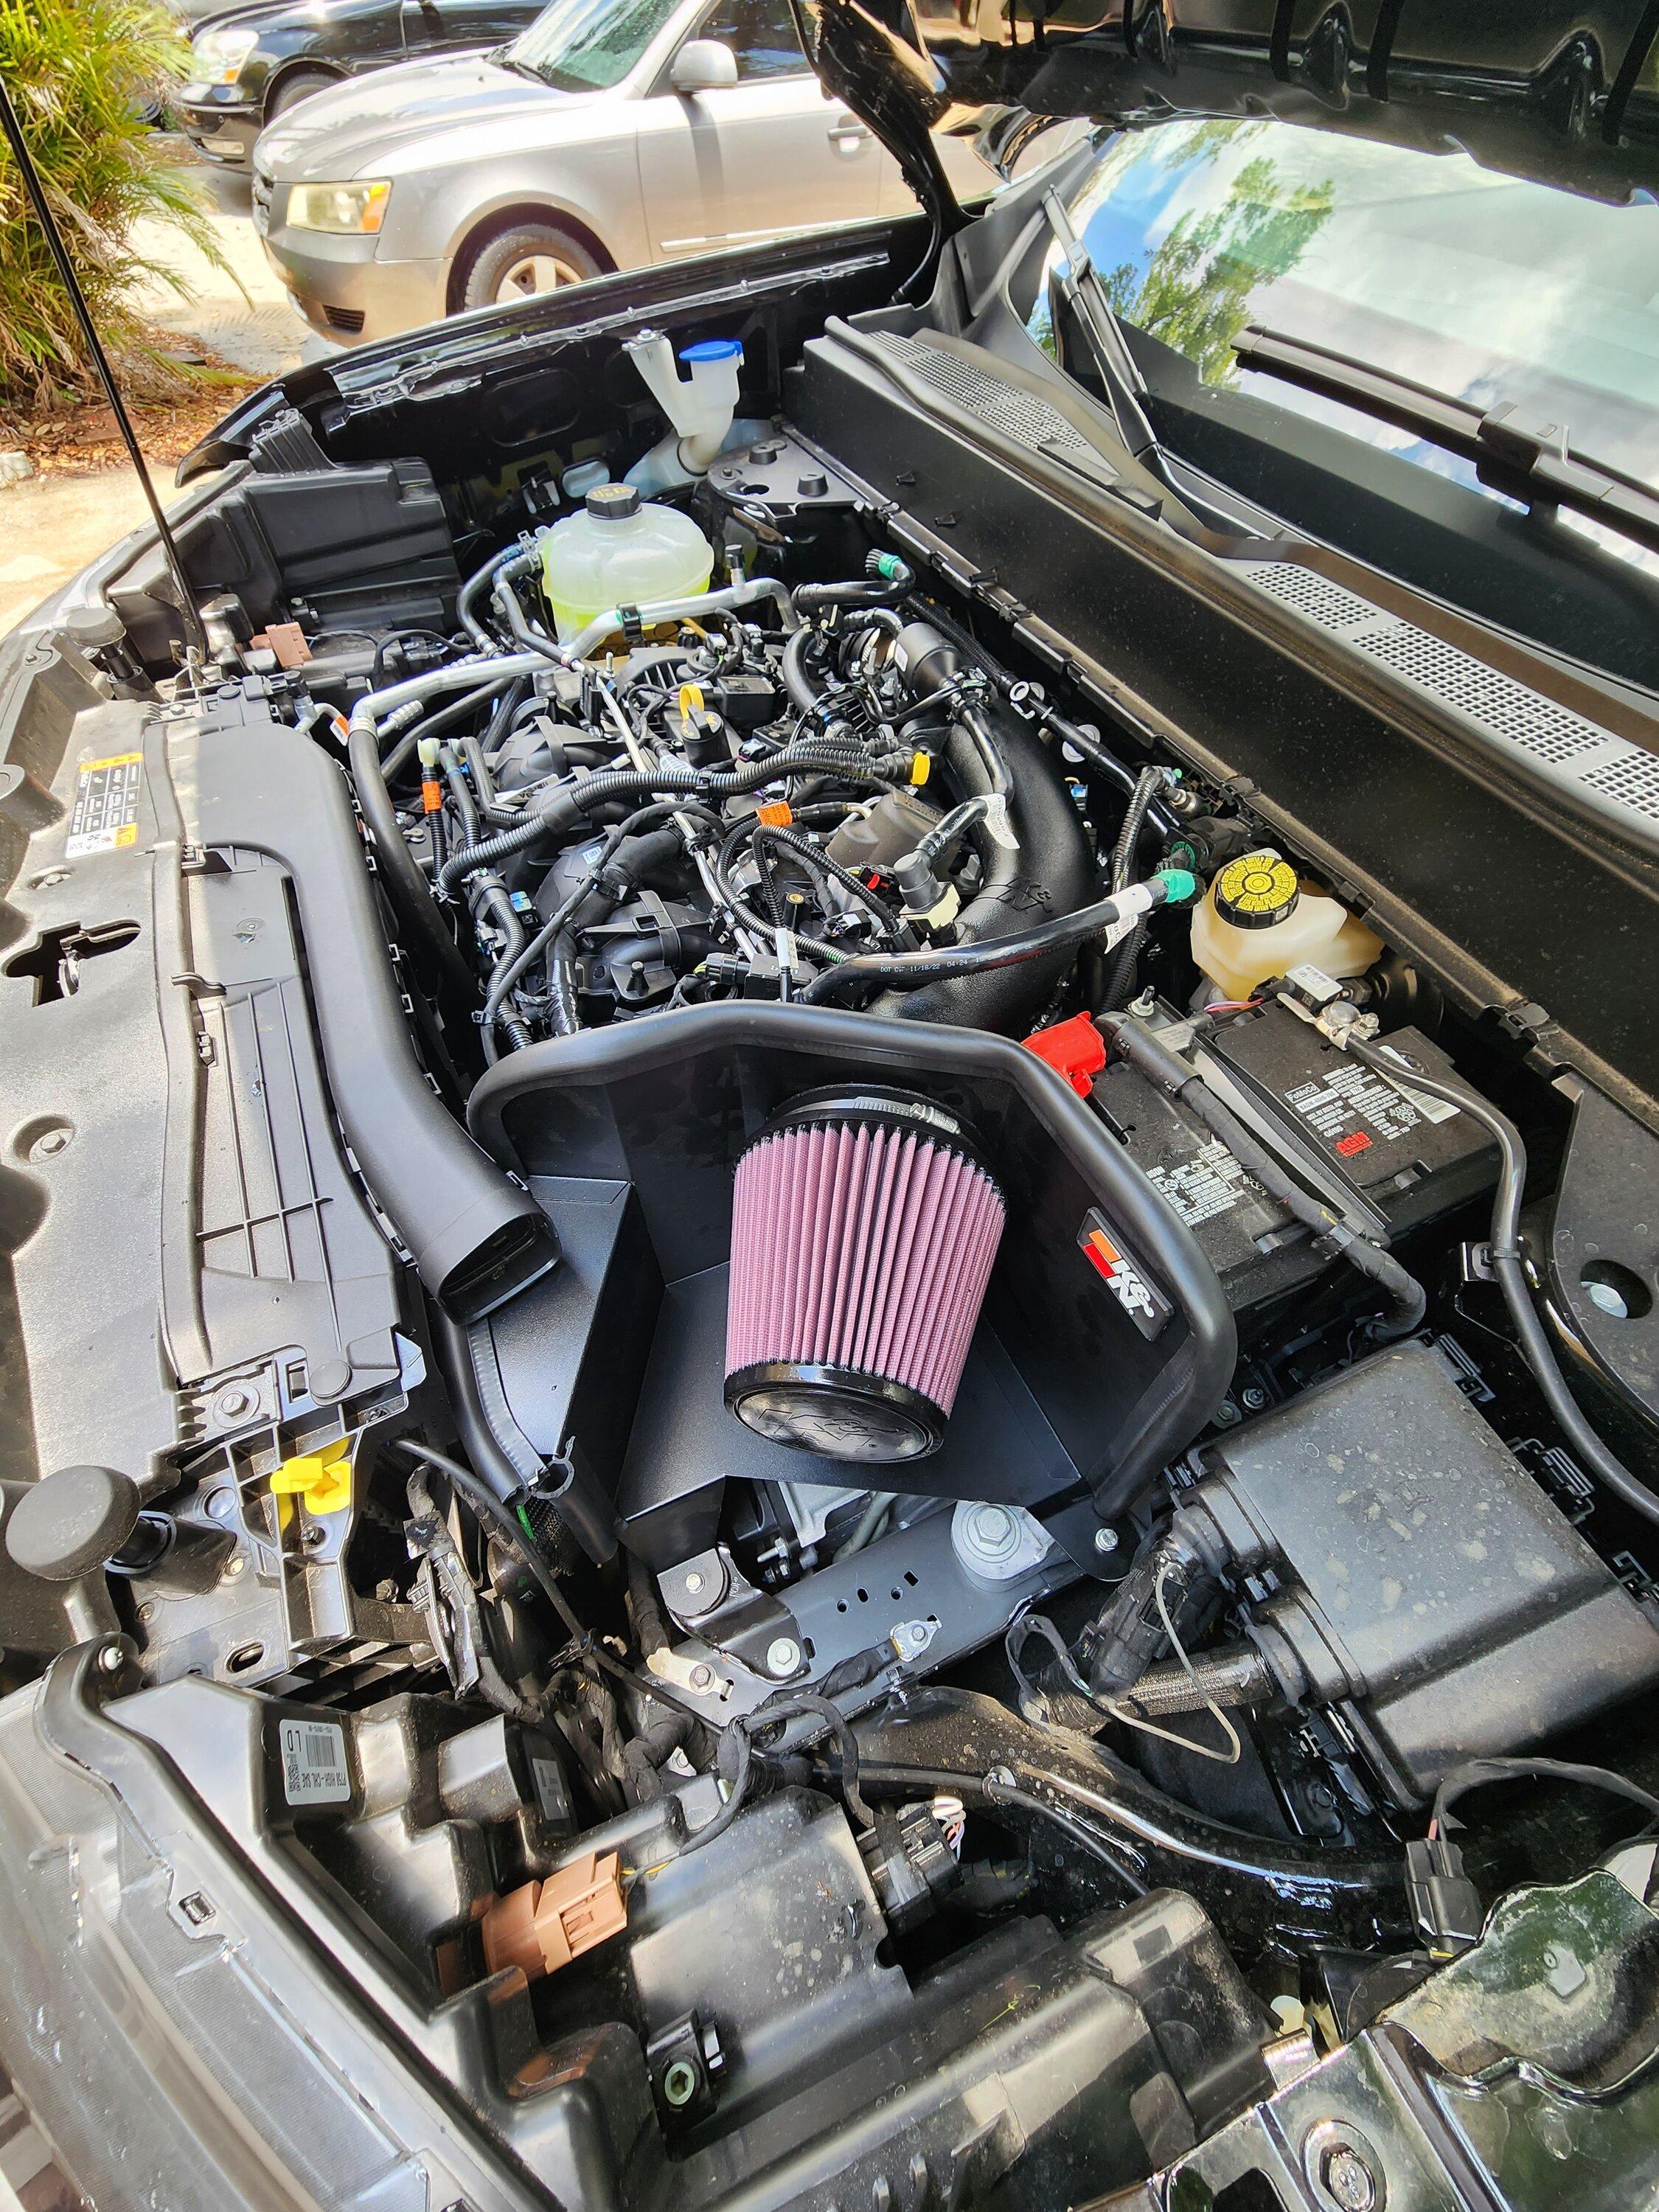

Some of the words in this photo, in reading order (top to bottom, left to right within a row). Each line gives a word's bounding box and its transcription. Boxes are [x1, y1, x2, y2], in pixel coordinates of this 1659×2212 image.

[910, 963, 940, 973] 11/18/22
[1289, 1086, 1318, 1101] FoMoCo
[1335, 1131, 1371, 1153] AGM
[288, 1730, 302, 1752] LD
